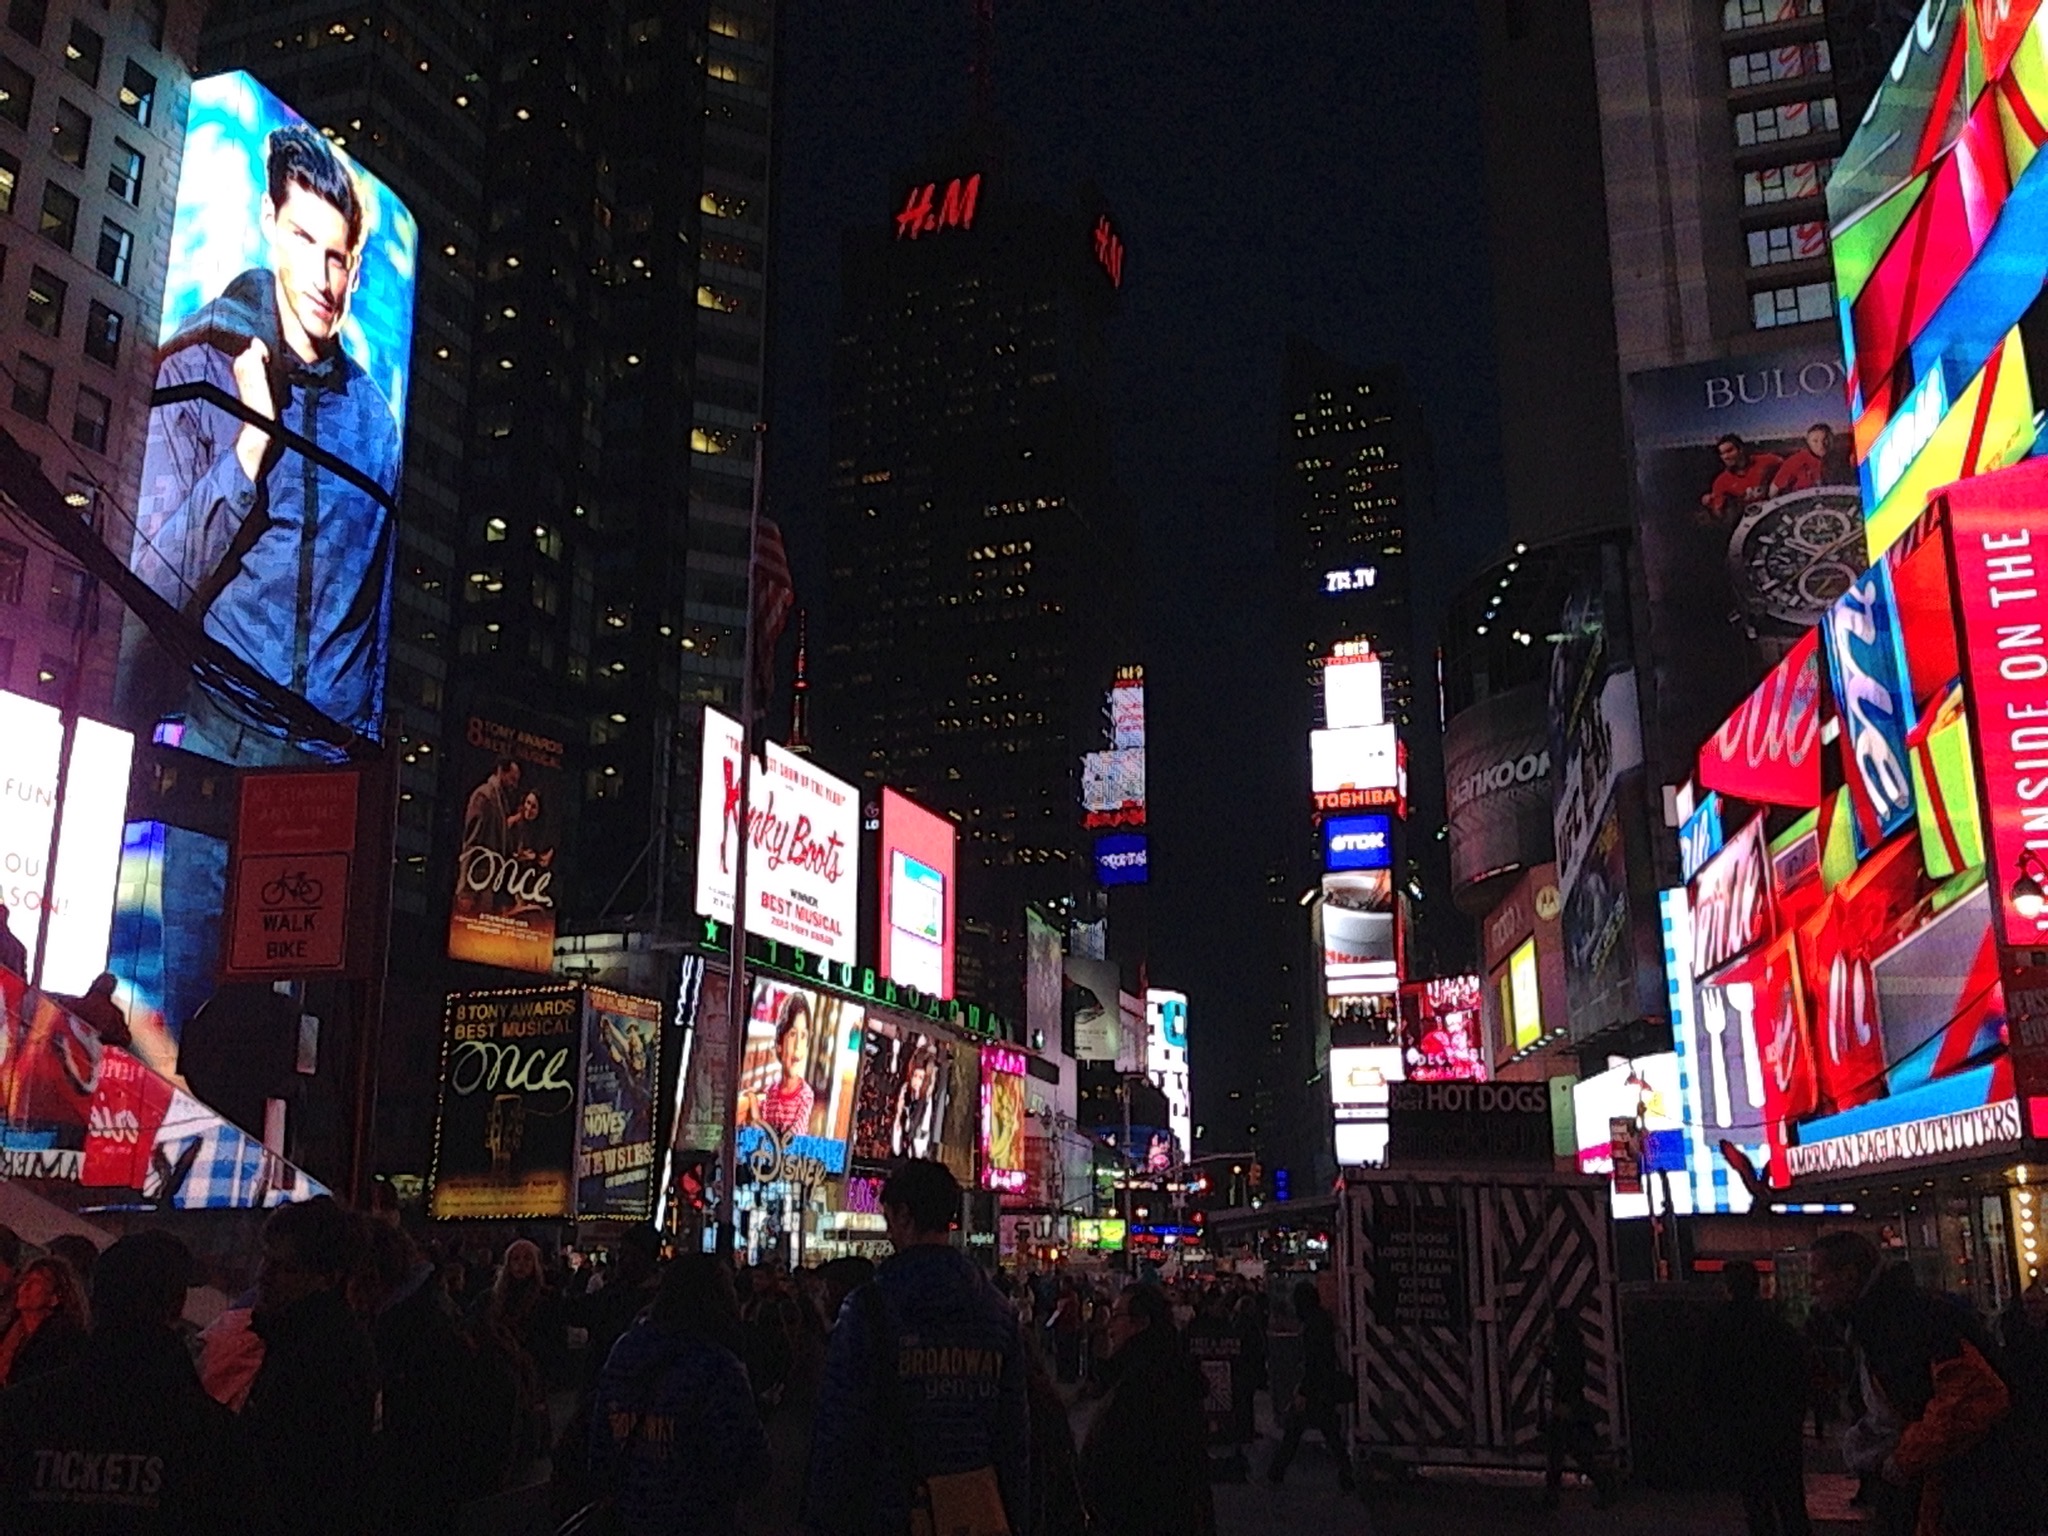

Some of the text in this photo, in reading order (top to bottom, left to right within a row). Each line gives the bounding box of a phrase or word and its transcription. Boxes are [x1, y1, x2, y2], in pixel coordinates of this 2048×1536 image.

[896, 173, 981, 240] H&M
[1981, 529, 2038, 609] THE
[1996, 624, 2048, 680] ON
[1314, 788, 1397, 811] TOSHIBA
[787, 813, 845, 884] Boots
[262, 912, 316, 932] WALK
[760, 890, 792, 918] BEST
[794, 903, 843, 937] MUSICAL
[265, 940, 308, 959] BIKE
[456, 1003, 466, 1021] 8
[468, 1003, 509, 1021] TONY
[510, 999, 576, 1018] AWARDS
[768, 937, 1014, 1046] 1540 BROADWAY
[454, 1019, 574, 1040] BEST MUSICAL
[1427, 1084, 1475, 1111] HOT
[1478, 1084, 1548, 1112] DOGS
[1787, 1101, 2019, 1177] AMERICAN EAGLE OUTFITTERS
[898, 1347, 1005, 1379] BROADWAY
[33, 1449, 165, 1494] TICKETS
